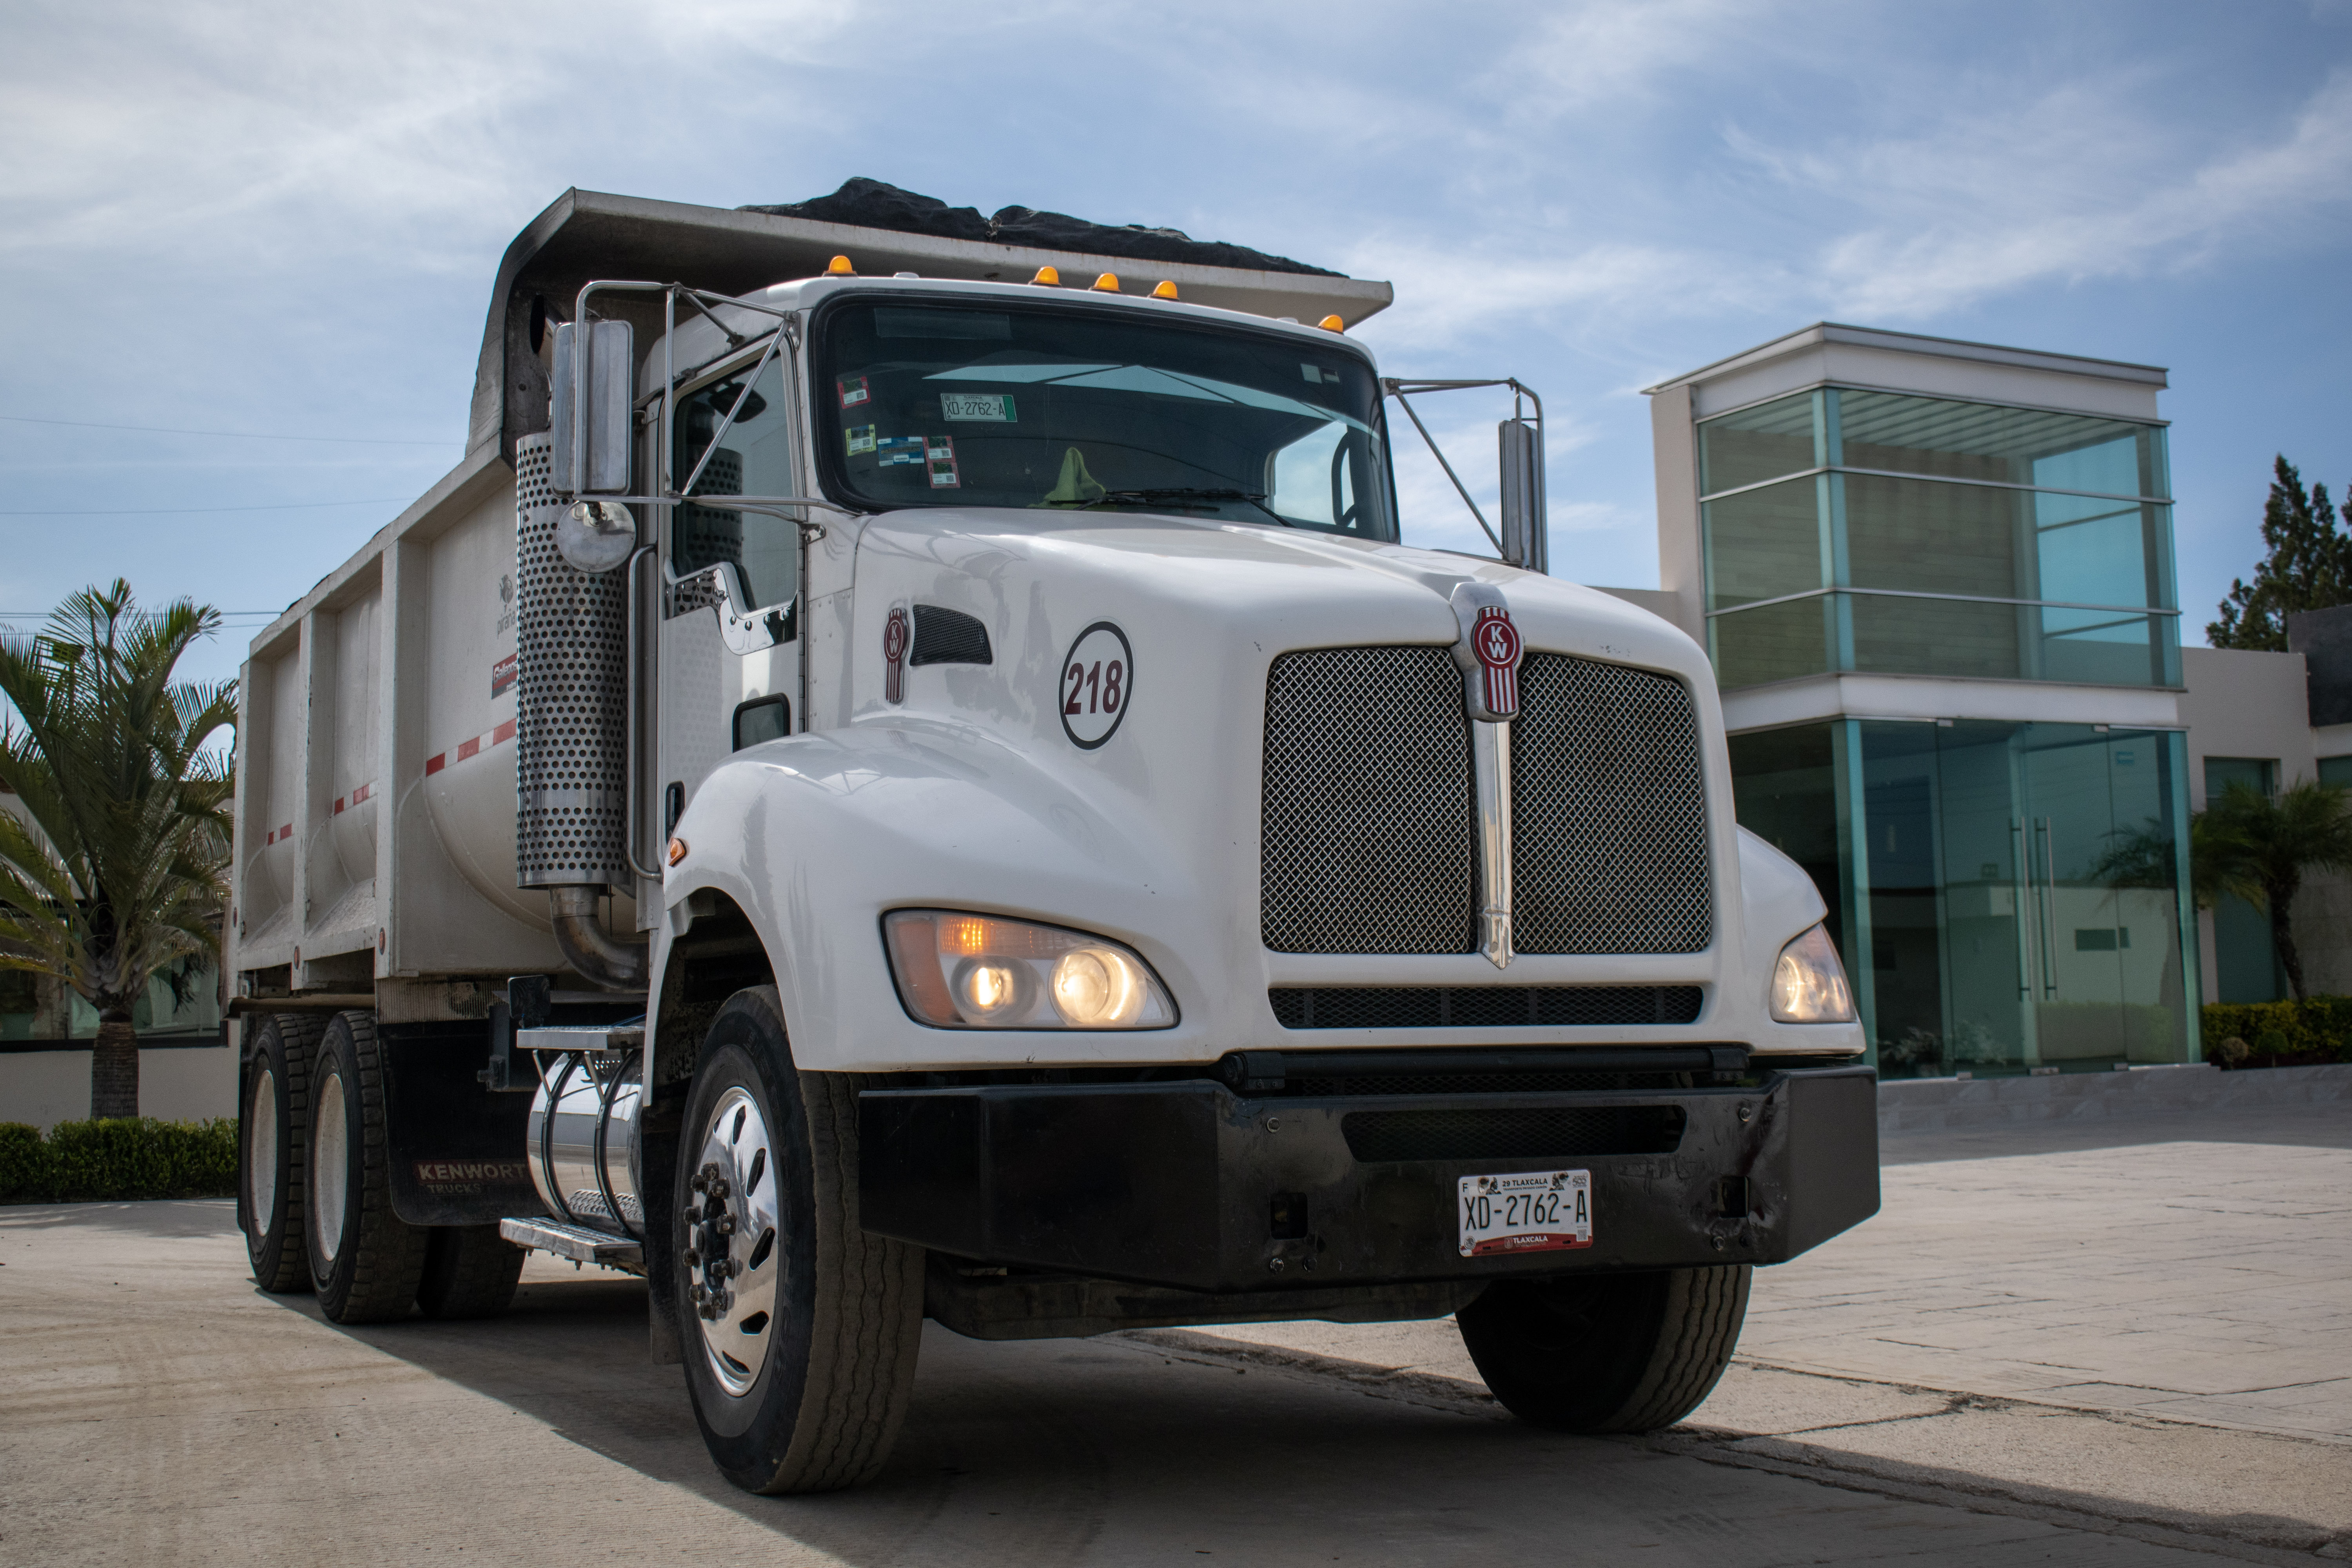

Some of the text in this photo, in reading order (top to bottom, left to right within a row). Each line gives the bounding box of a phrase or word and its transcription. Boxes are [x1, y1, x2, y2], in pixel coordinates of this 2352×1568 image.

[945, 401, 1005, 416] XD-2762-A
[497, 608, 515, 639] piraña
[1064, 660, 1123, 715] 218
[417, 1163, 526, 1180] KENWORT
[426, 1184, 482, 1194] TRUCKS
[1463, 1183, 1468, 1192] F
[1512, 1178, 1548, 1187] TLAXCALA
[1464, 1189, 1587, 1231] XD-2762-A
[1513, 1235, 1548, 1244] TLAXCALA
